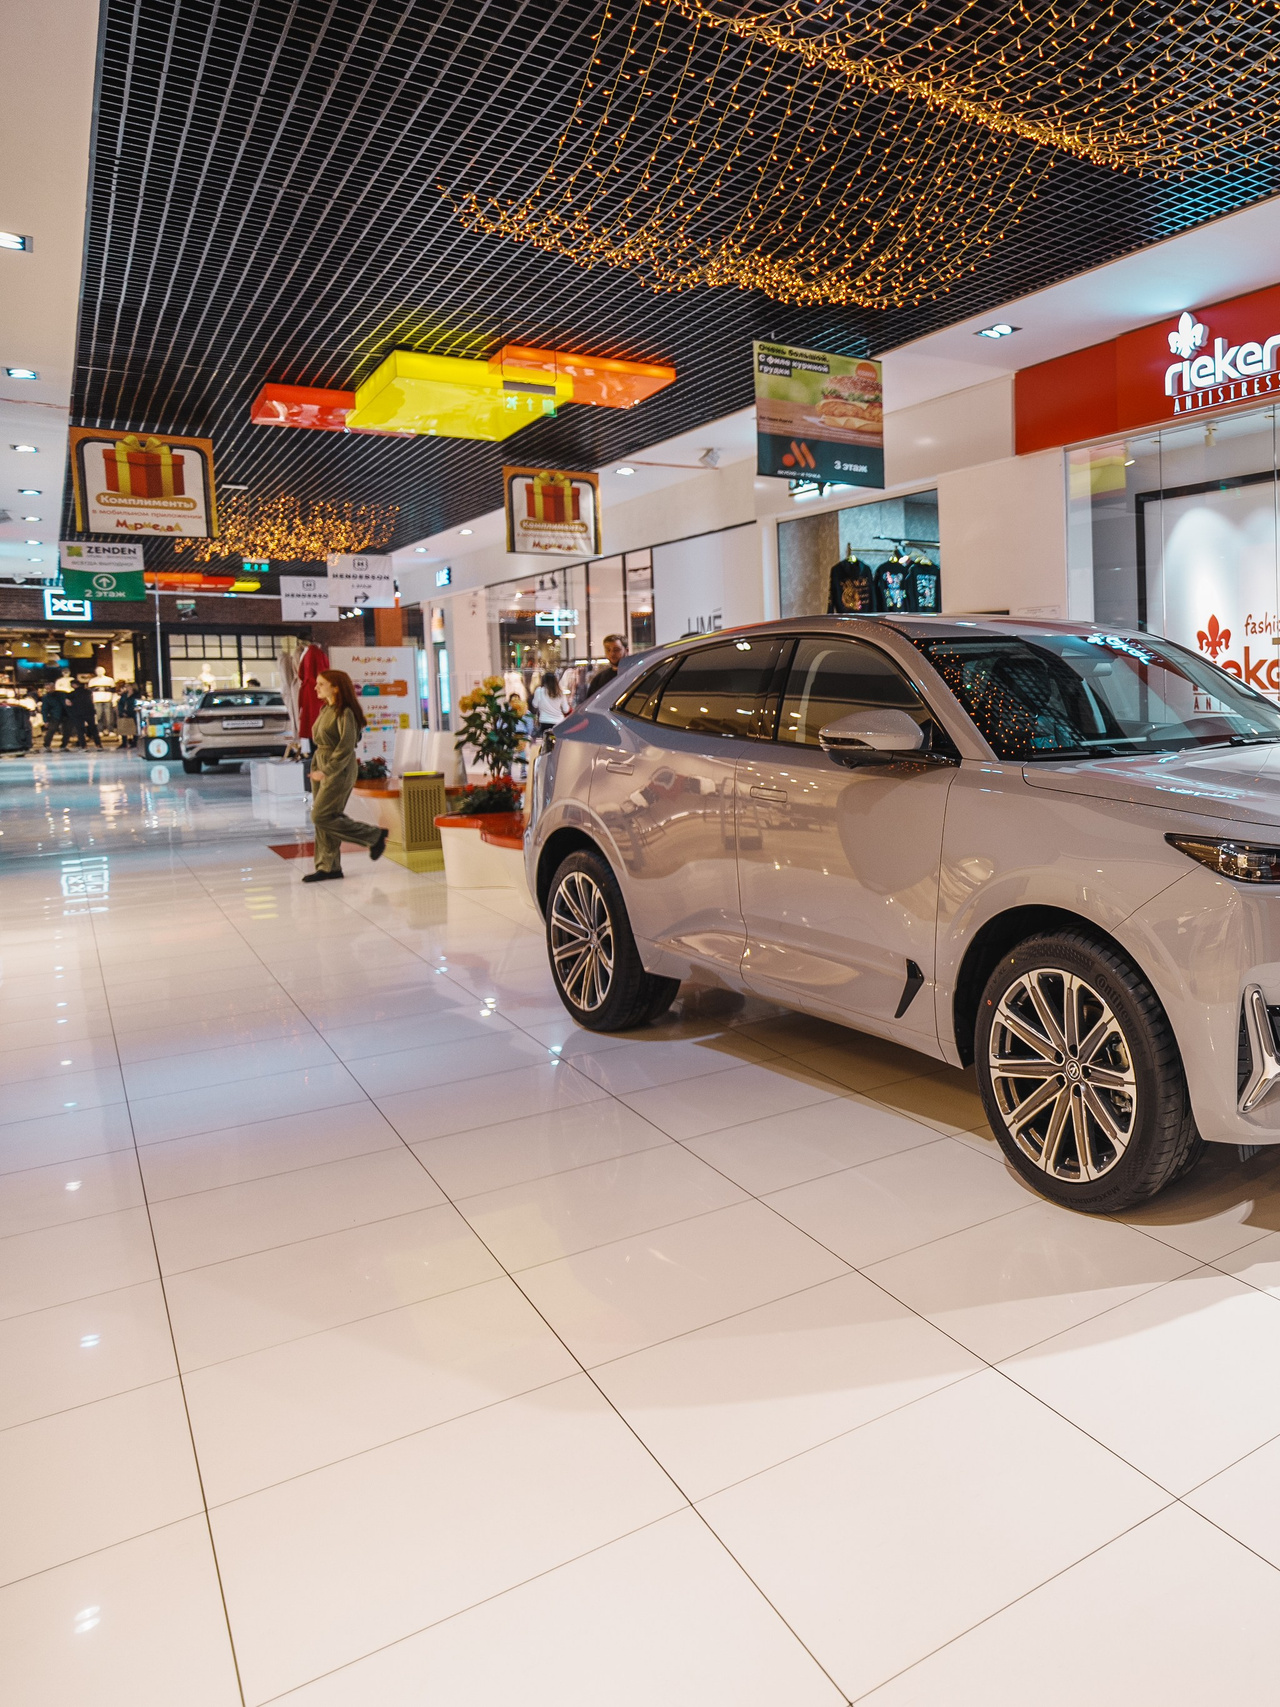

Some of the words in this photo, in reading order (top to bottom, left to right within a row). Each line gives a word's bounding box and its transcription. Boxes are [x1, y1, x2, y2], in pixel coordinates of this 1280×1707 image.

[834, 460, 842, 470] 3
[843, 463, 868, 474] этаж
[100, 495, 194, 510] Комплименты
[86, 546, 137, 555] ZENDEN
[84, 589, 93, 598] 2
